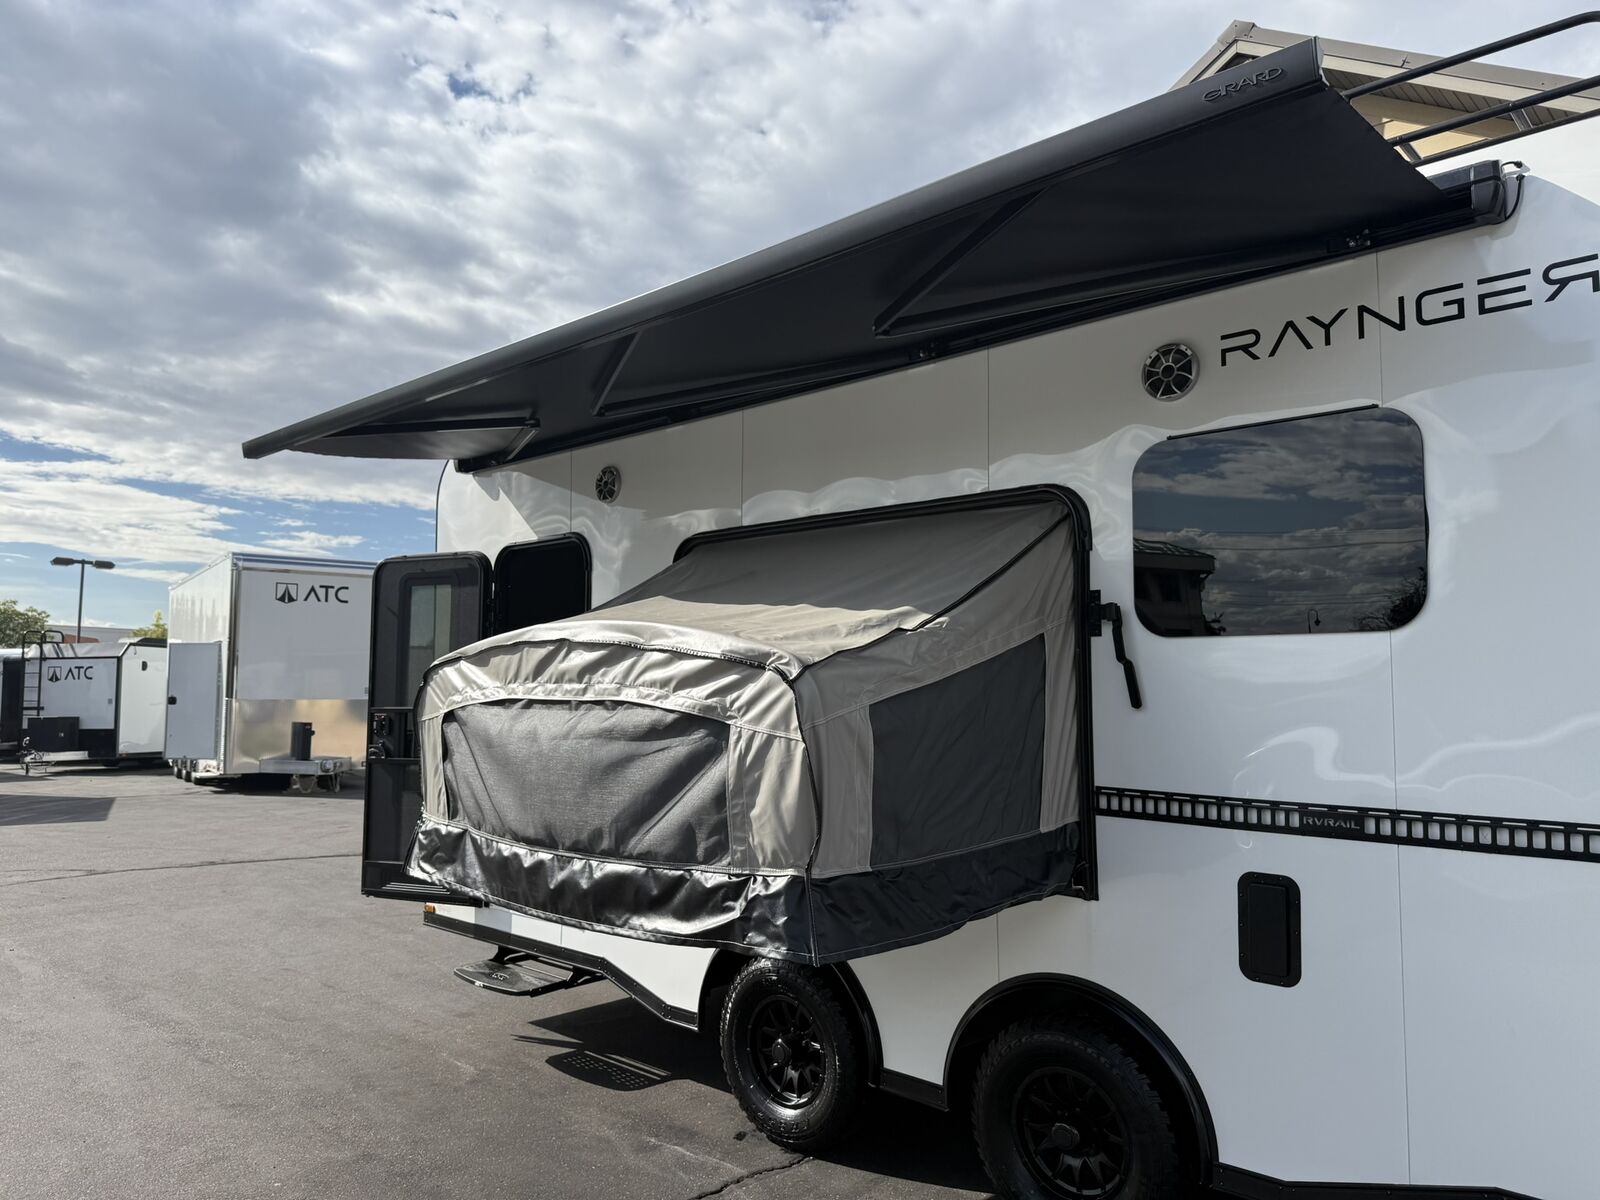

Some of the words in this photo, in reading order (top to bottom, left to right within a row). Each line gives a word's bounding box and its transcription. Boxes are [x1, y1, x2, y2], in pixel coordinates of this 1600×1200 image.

[1220, 253, 1600, 367] RAYNGER
[303, 585, 350, 604] ATC
[64, 665, 94, 681] ATC
[1303, 815, 1361, 830] RVRAIL
